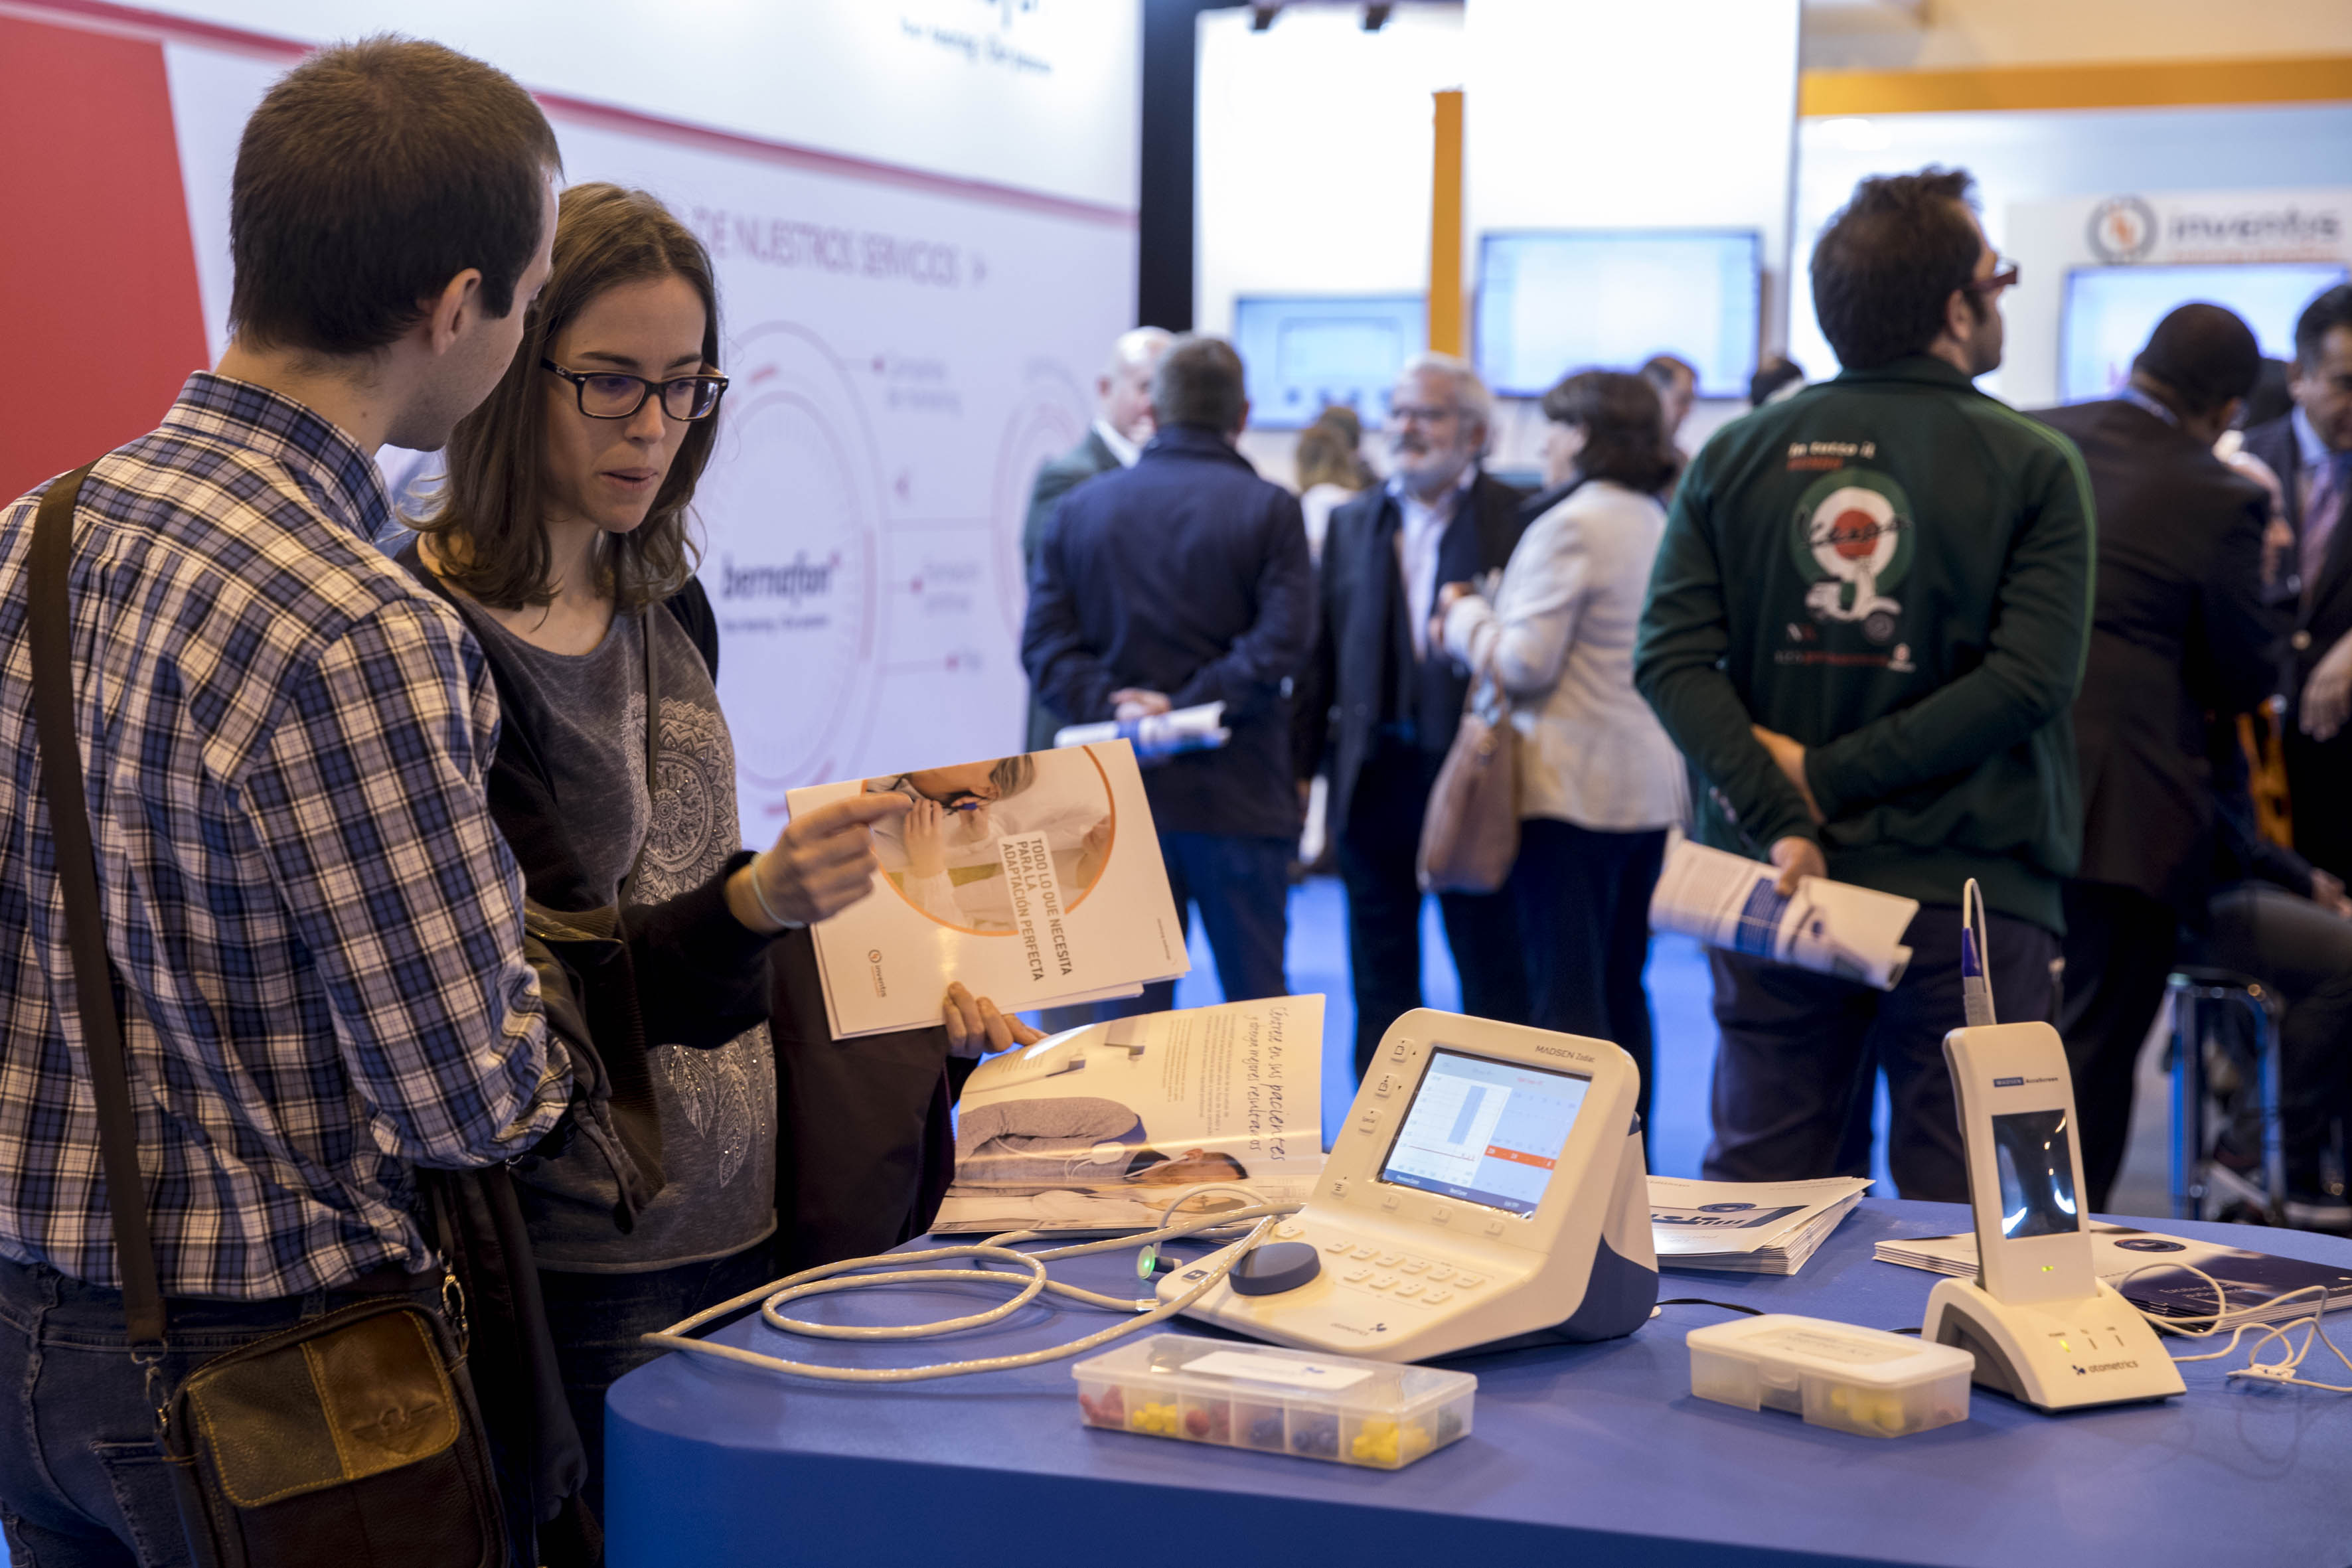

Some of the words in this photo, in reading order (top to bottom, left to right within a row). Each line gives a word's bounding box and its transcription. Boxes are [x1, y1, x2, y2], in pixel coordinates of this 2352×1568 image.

[732, 215, 854, 275] NUESTROS
[861, 231, 963, 289] SERVICIOS
[1016, 841, 1033, 873] PARA
[1031, 838, 1048, 870] TODO
[1024, 875, 1038, 892] LA
[1039, 873, 1053, 889] LO
[1002, 844, 1032, 917] ADAPTACIÓN
[1020, 919, 1044, 981] PERFECTA
[1043, 892, 1059, 917] QUE
[1050, 918, 1073, 975] NECESITA
[1241, 1049, 1259, 1081] mejores
[1267, 1046, 1283, 1060] en
[1535, 1045, 1575, 1059] MADSEN
[1267, 1063, 1283, 1078] sus
[1259, 1083, 1287, 1161] pacientes
[2088, 1360, 2139, 1373] otometrics
